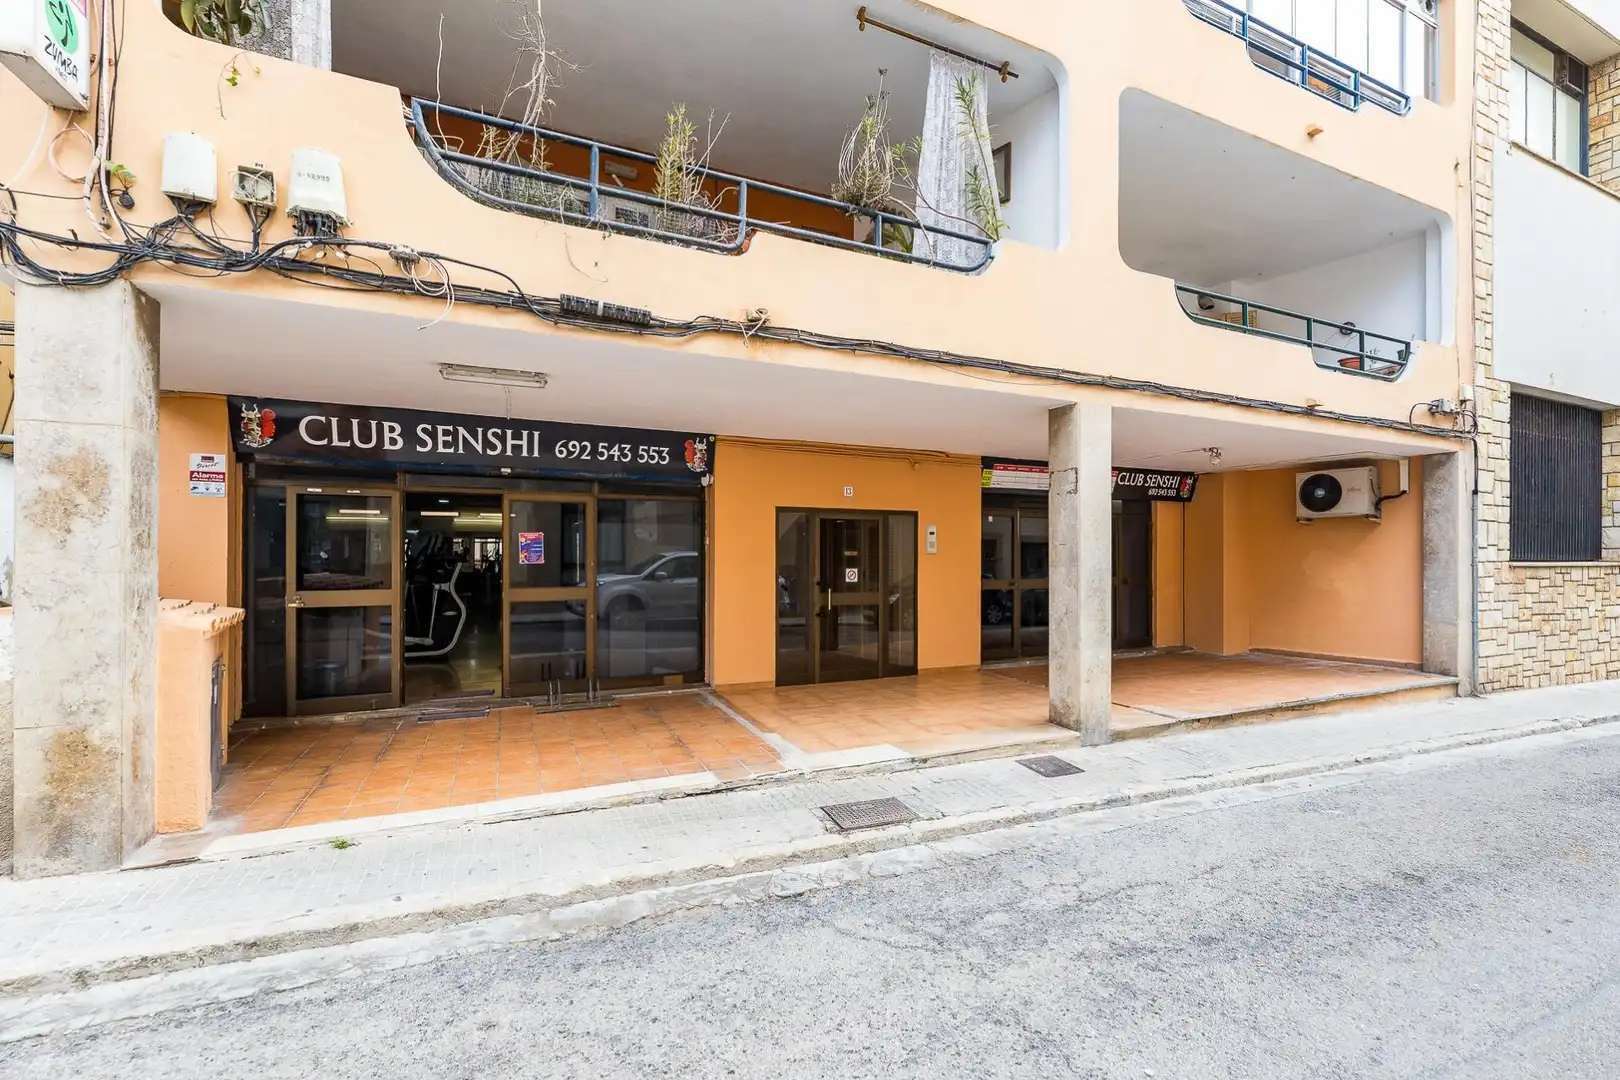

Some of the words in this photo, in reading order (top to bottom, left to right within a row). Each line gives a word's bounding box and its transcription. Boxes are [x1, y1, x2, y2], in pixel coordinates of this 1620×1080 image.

[44, 34, 78, 82] ZUMBA
[298, 415, 404, 451] CLUB
[416, 423, 541, 458] SENSHI
[555, 440, 591, 460] 692
[597, 443, 632, 463] 543
[637, 445, 670, 465] 553
[1118, 472, 1144, 486] CLUB
[1145, 474, 1180, 488] SENSHI
